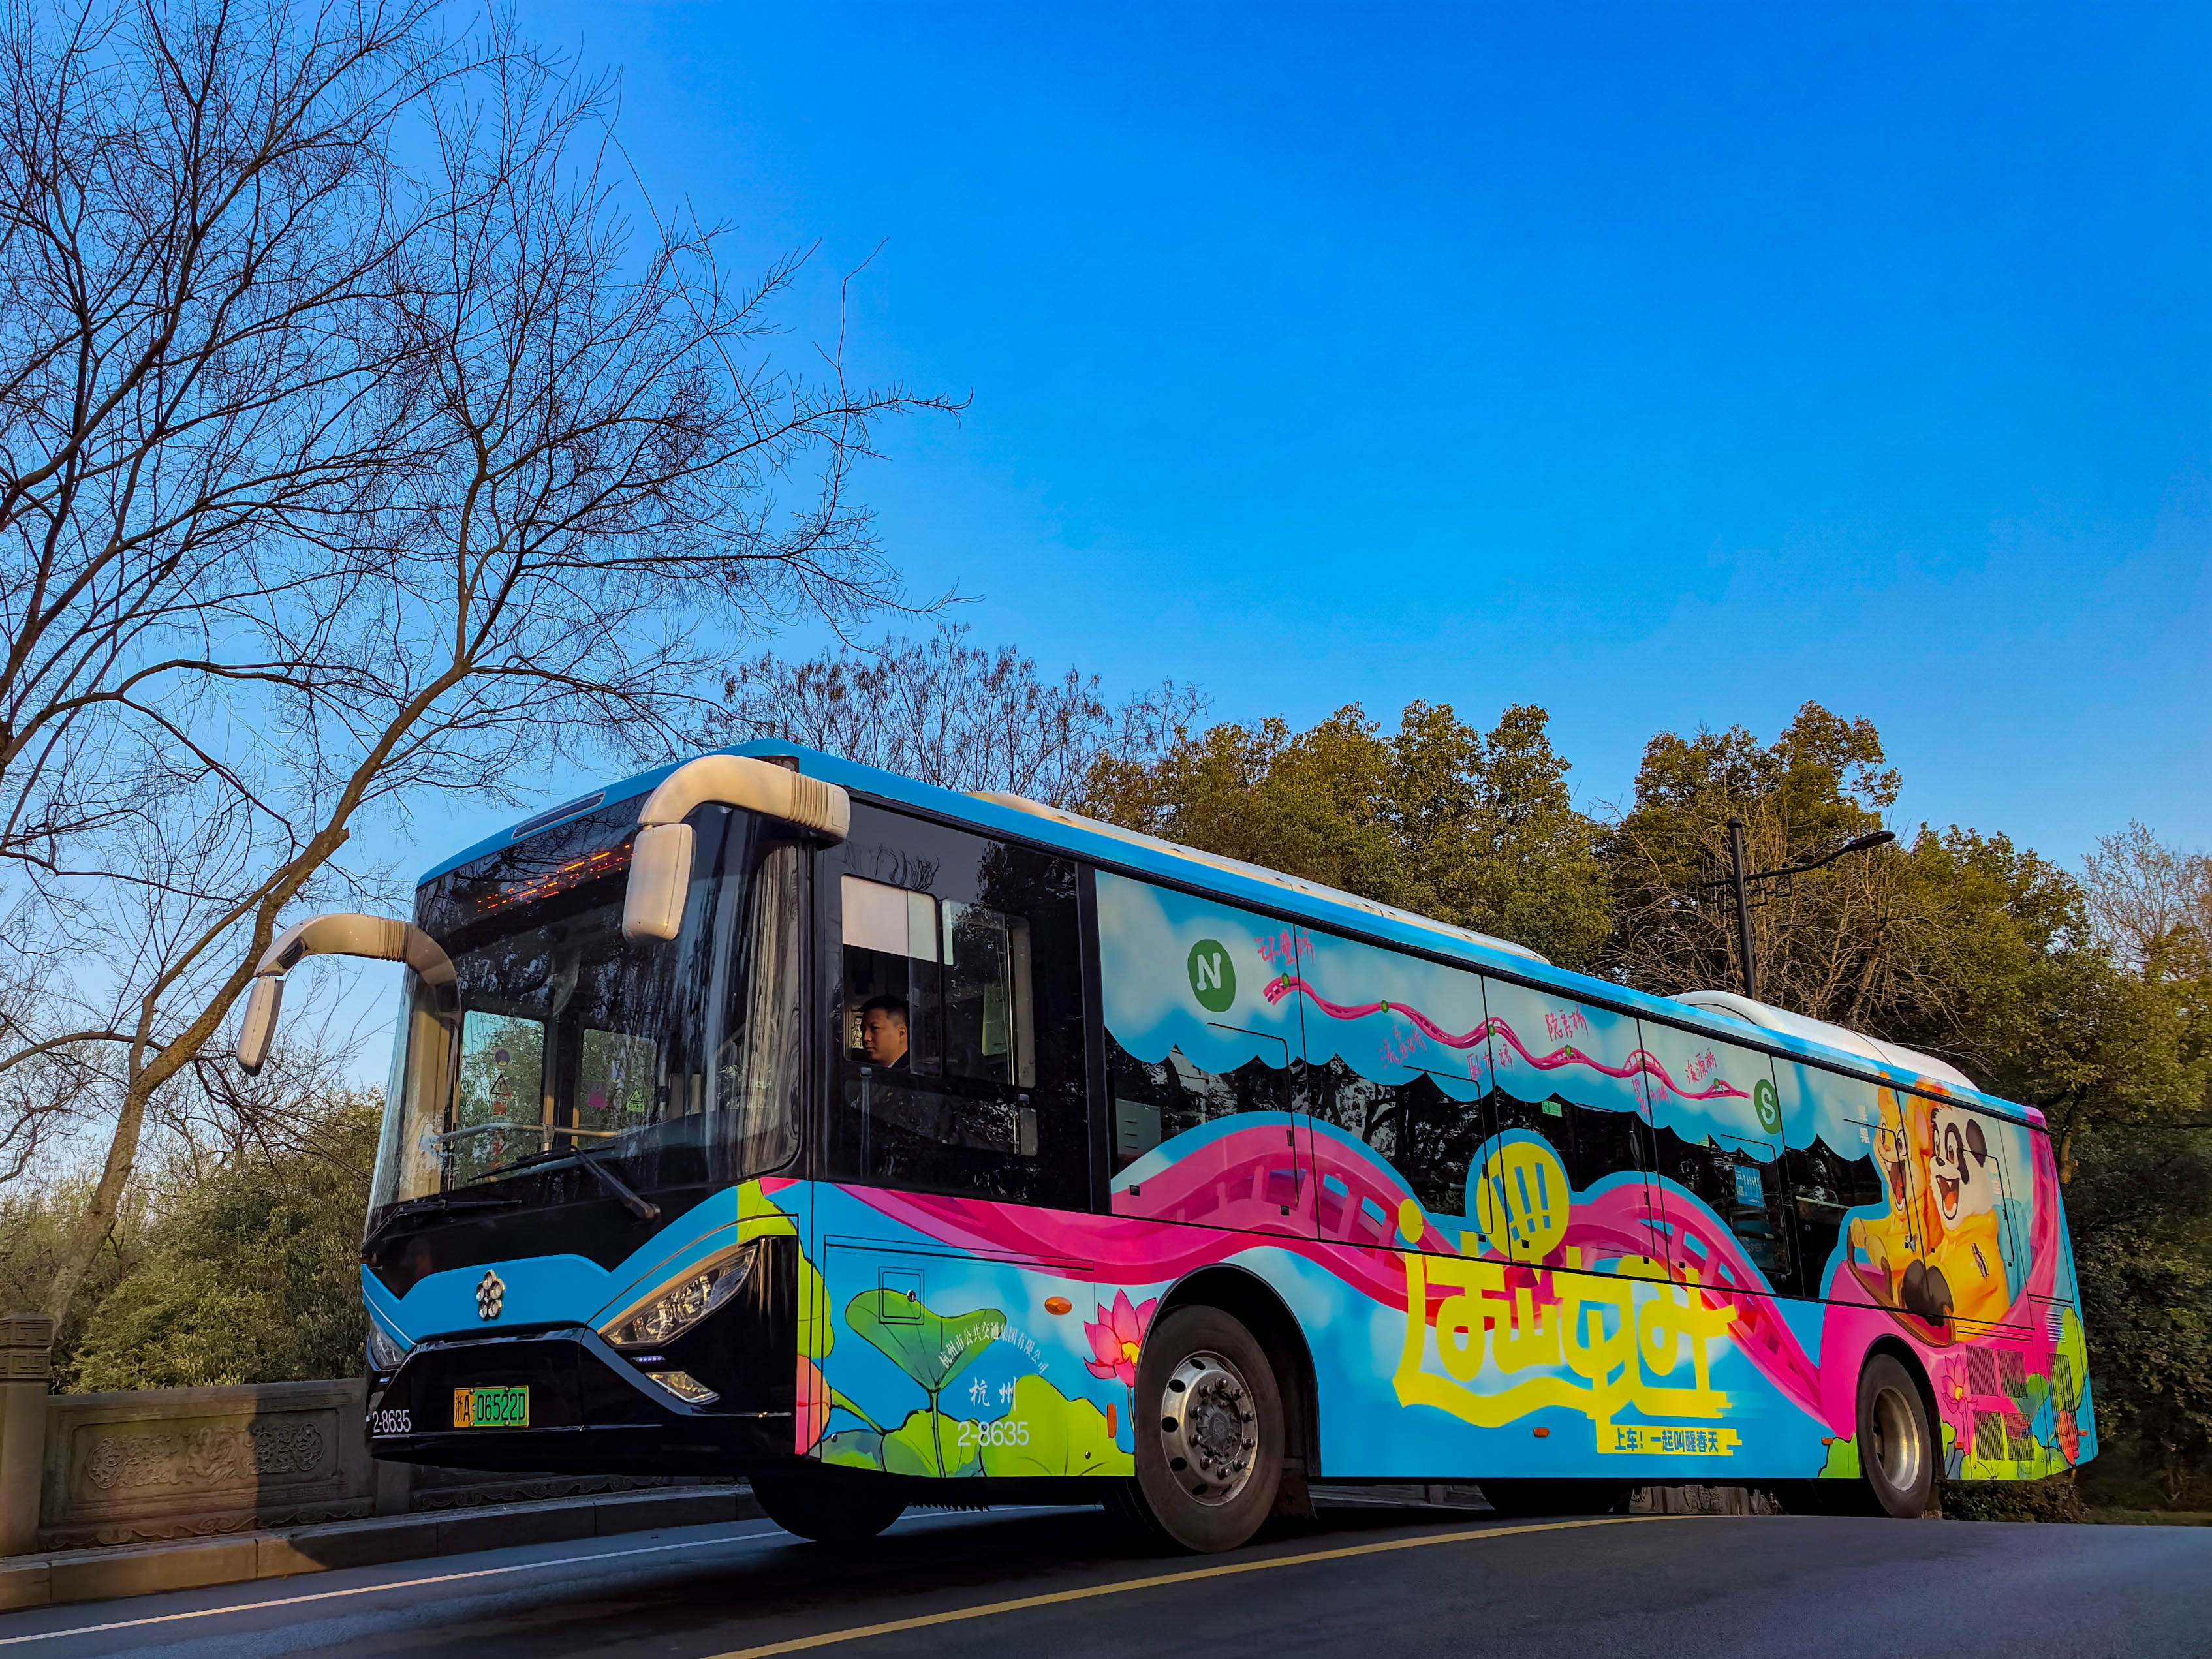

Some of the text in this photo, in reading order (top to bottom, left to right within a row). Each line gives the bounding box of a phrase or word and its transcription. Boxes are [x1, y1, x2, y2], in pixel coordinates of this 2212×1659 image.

[1197, 952, 1221, 991] N
[1760, 1089, 1776, 1124] S
[937, 1321, 1049, 1374] 杭州市公共交通集团有限公司
[969, 1376, 1018, 1412] 杭州
[373, 1409, 411, 1433] 2-8635
[957, 1420, 1030, 1447] 2-8635
